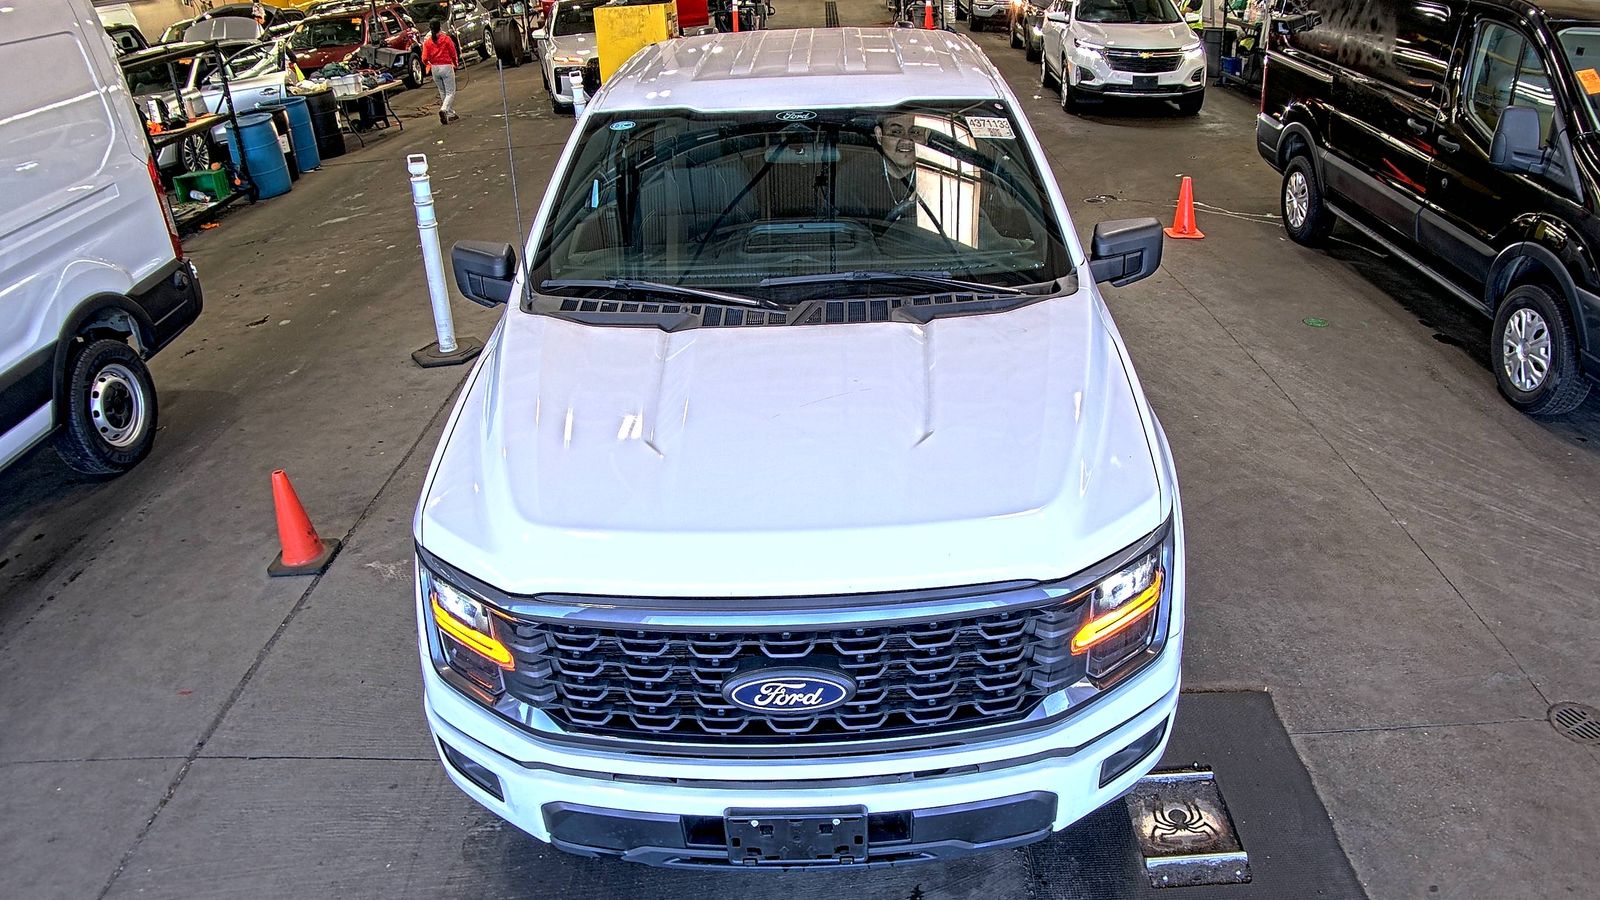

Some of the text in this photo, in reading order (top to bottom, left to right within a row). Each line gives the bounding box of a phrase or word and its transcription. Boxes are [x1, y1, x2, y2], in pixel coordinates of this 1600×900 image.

[783, 111, 810, 120] Ford
[969, 118, 1010, 129] 4371133
[753, 682, 824, 706] Ford
